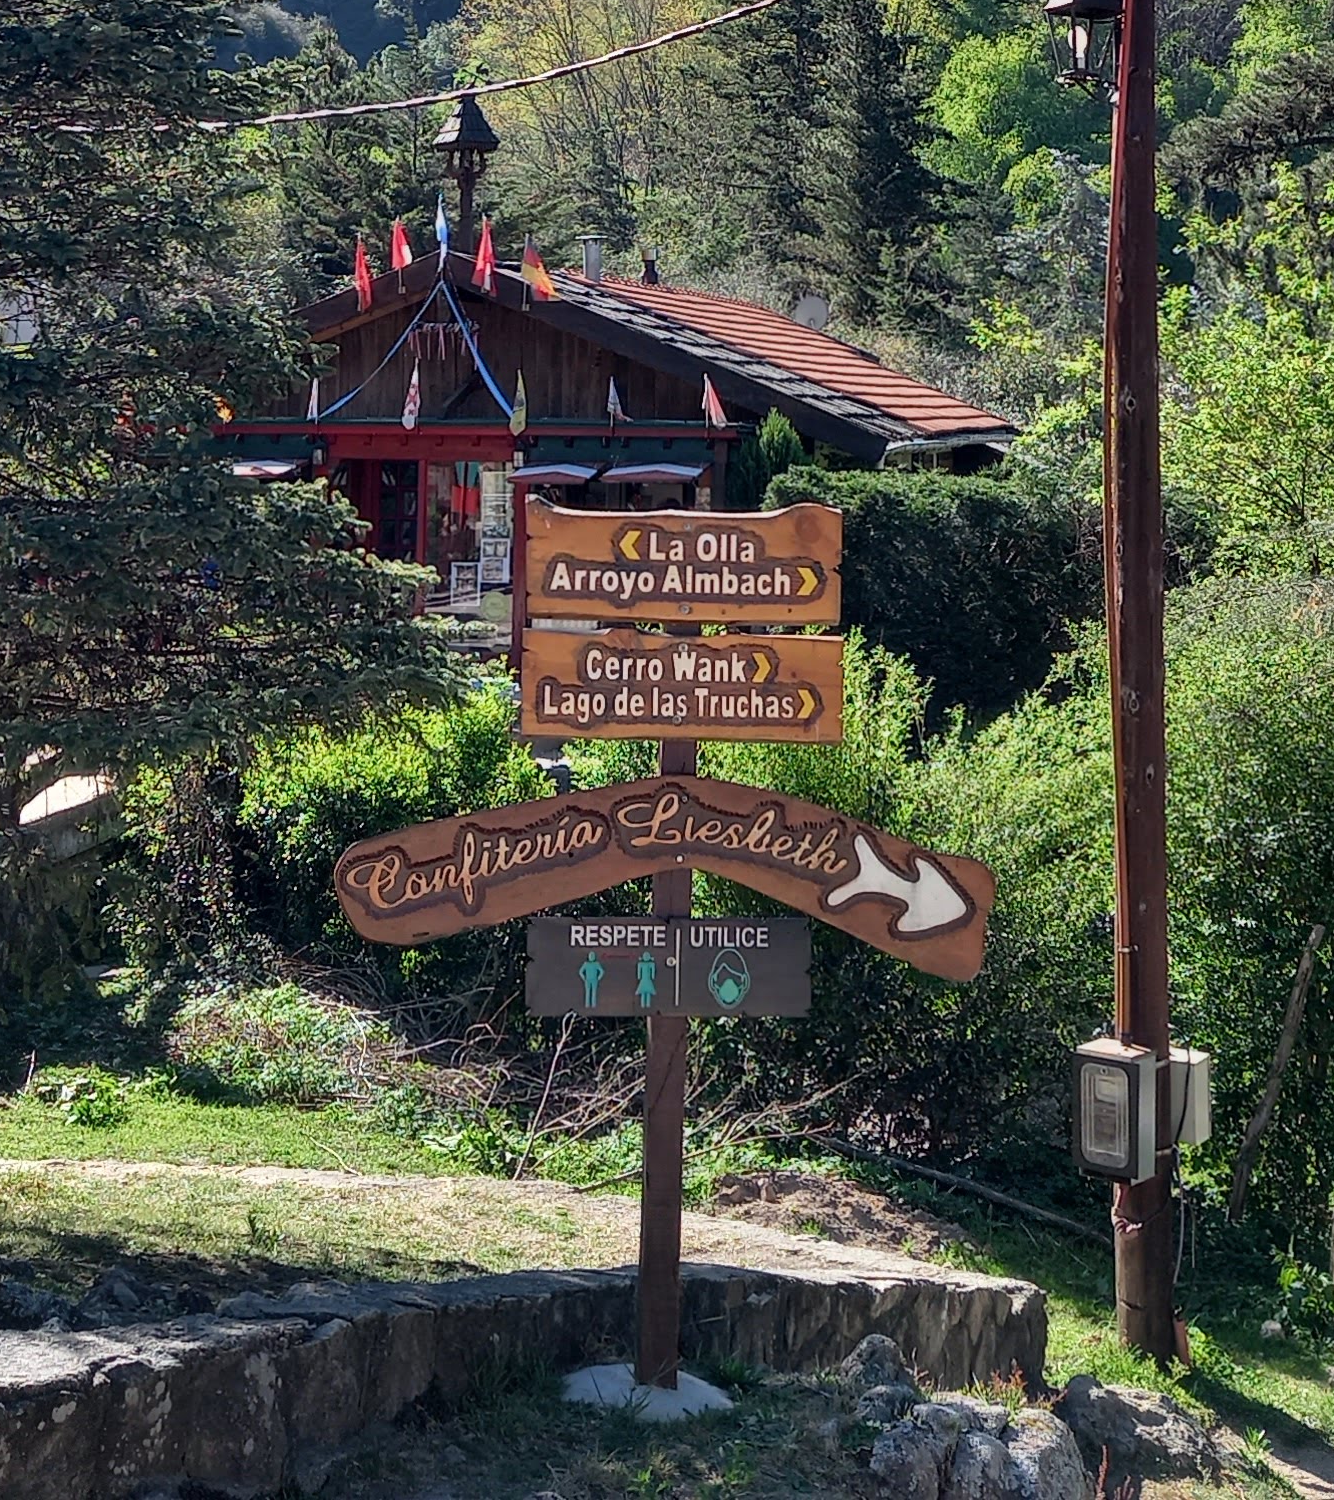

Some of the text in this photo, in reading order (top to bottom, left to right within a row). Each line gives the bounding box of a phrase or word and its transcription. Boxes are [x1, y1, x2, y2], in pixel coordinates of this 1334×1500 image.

[648, 531, 755, 563] La Olla
[549, 562, 791, 599] Arroyo Almbach
[585, 649, 747, 682] Cerro Wank
[543, 685, 794, 723] Lago de las Truchas
[617, 793, 848, 874] Liesbeth
[570, 925, 666, 947] RESPETE
[690, 926, 769, 948] UTILICE
